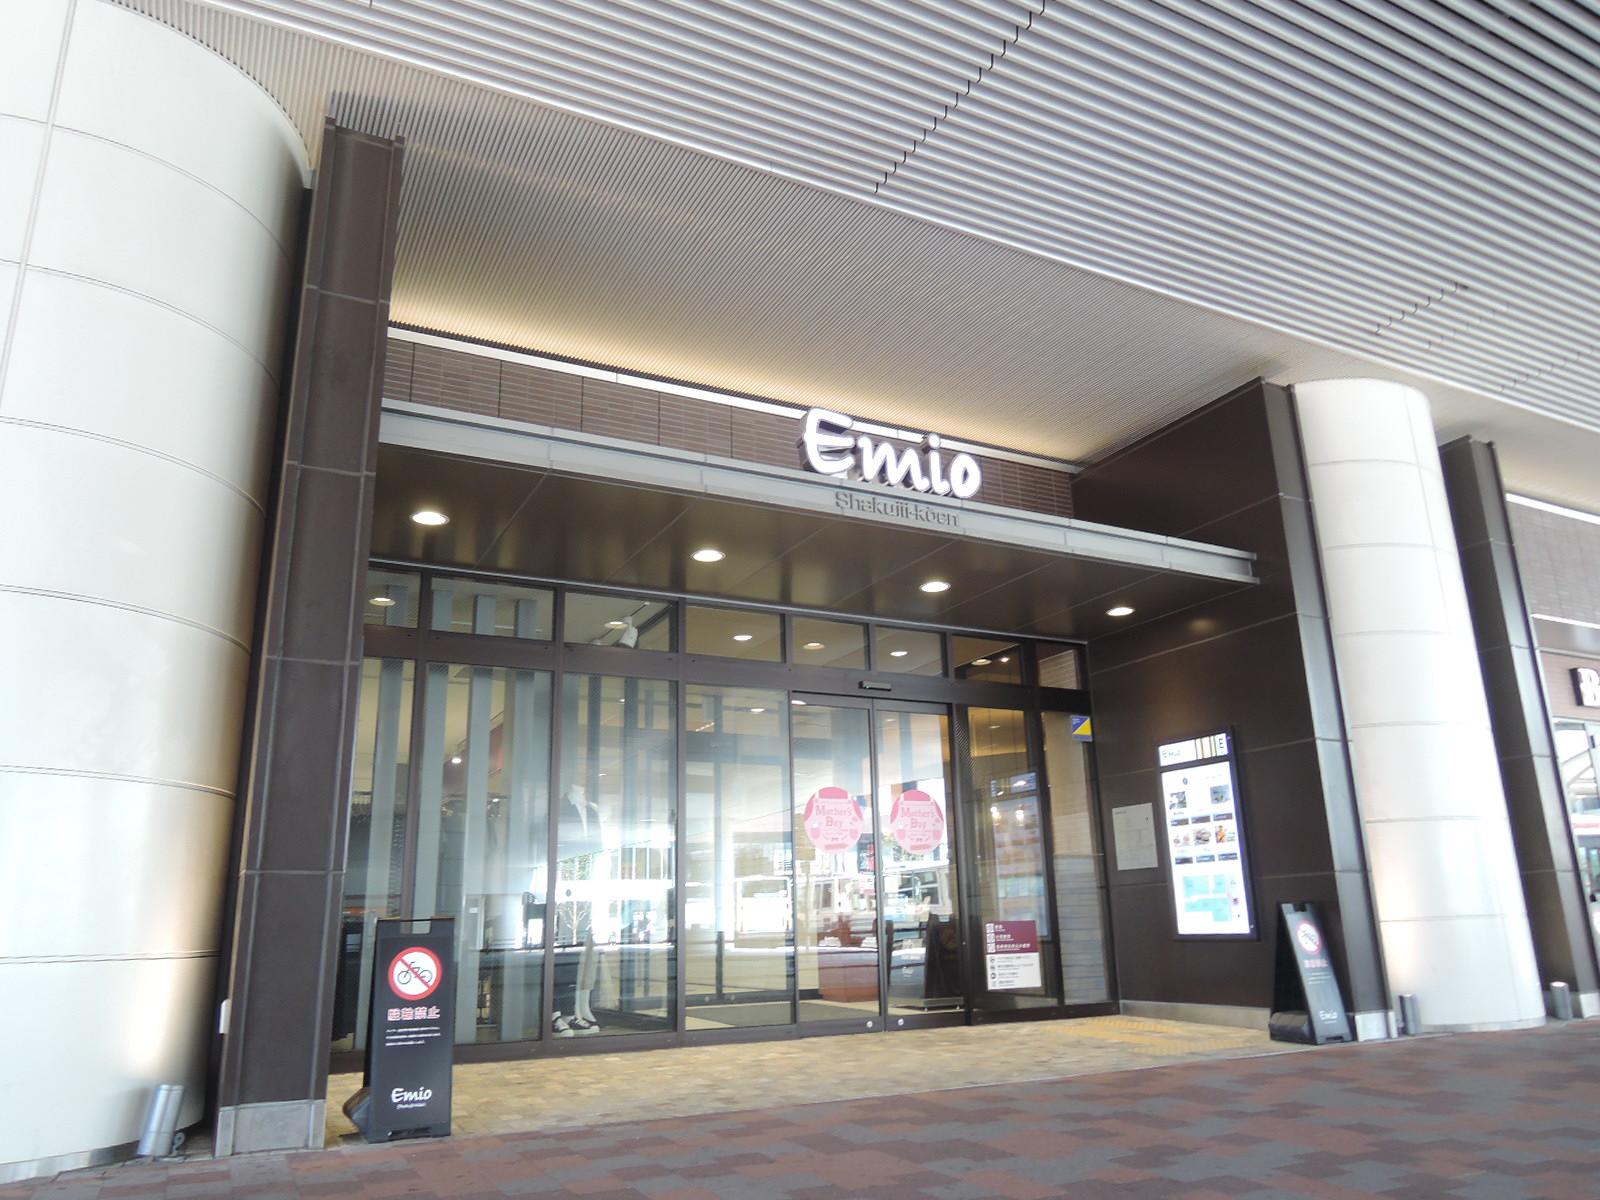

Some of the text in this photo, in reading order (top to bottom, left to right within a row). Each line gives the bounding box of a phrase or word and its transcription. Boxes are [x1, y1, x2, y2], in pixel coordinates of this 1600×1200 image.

[803, 407, 982, 498] Emio
[815, 804, 852, 817] Mother's
[901, 806, 935, 819] Mother's
[825, 817, 843, 828] Day
[910, 818, 927, 829] Day
[391, 1086, 432, 1103] Emio
